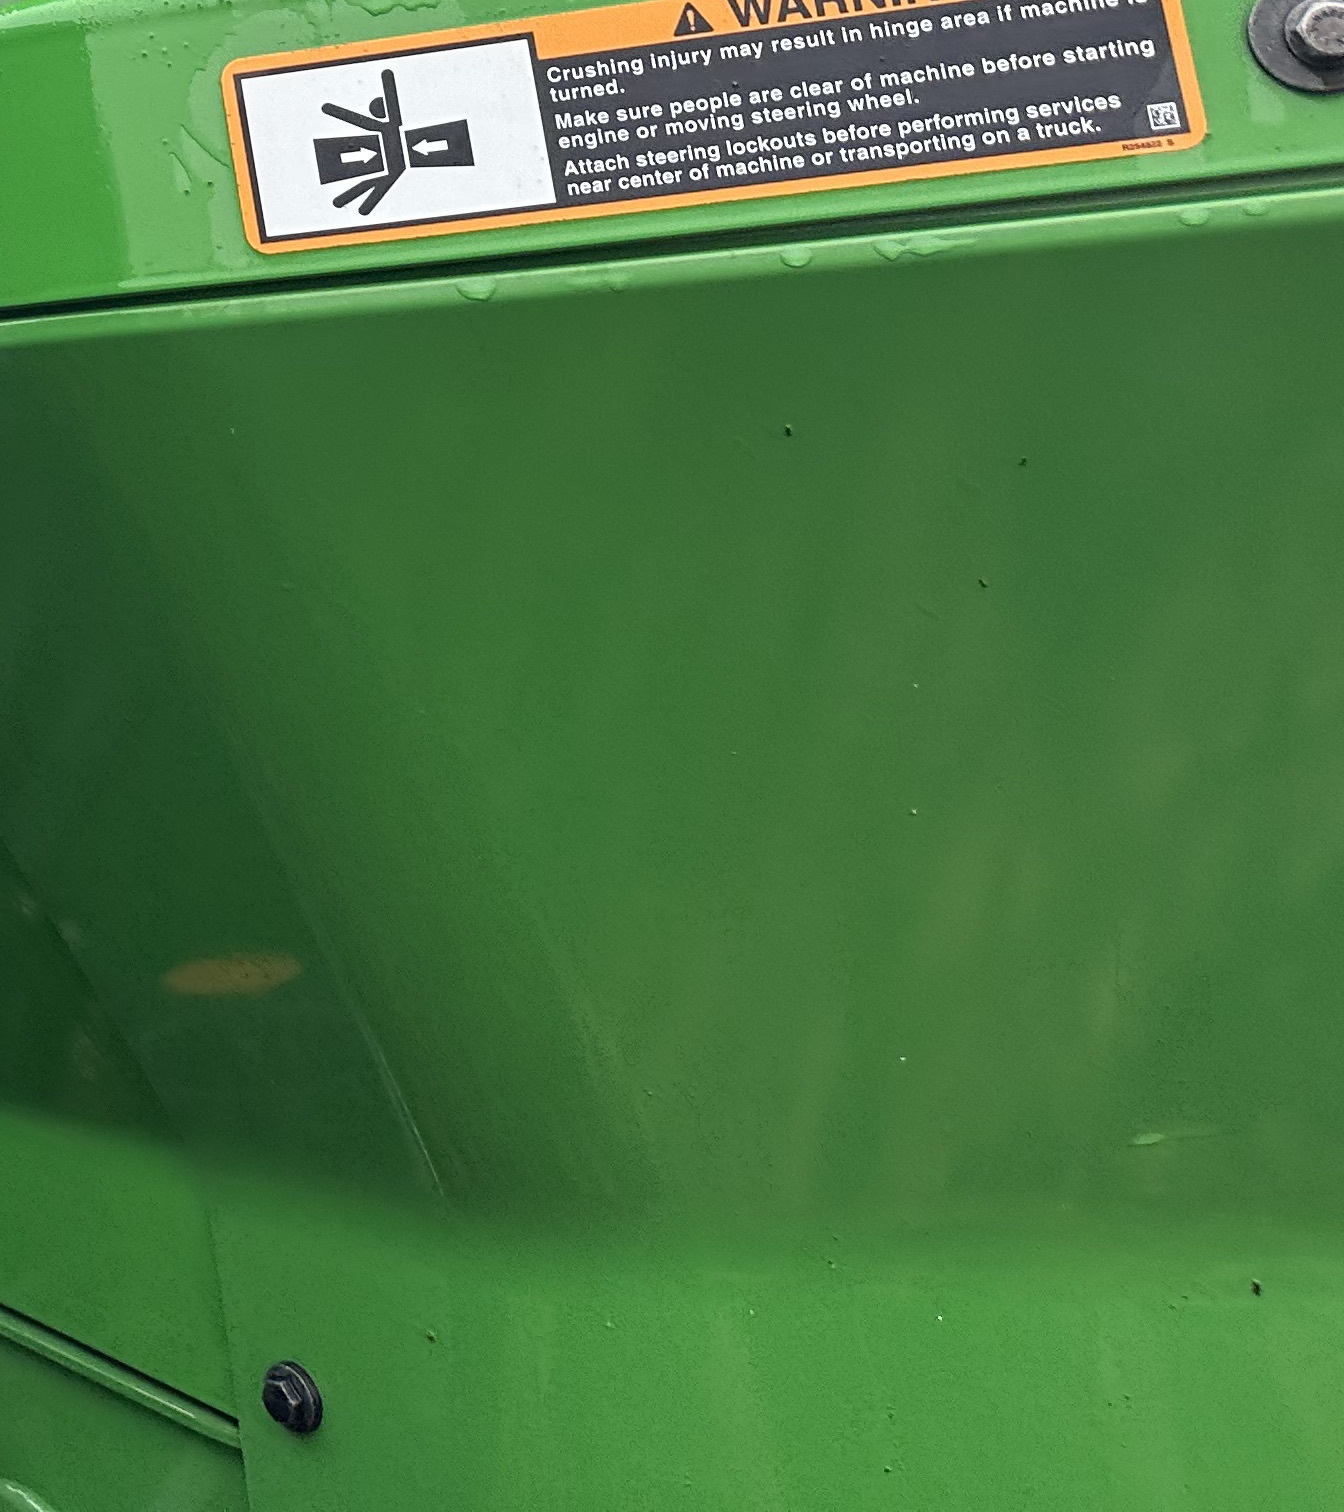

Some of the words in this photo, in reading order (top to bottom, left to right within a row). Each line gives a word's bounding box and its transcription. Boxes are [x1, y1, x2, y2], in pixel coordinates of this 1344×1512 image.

[547, 58, 643, 82] Crushing
[650, 49, 711, 70] injury
[720, 42, 763, 59] may
[772, 30, 835, 52] result
[841, 27, 862, 43] in
[870, 15, 932, 38] hinge
[941, 11, 989, 30] area
[997, 5, 1012, 22] if
[550, 80, 625, 102] turned.
[555, 110, 609, 129] Make
[616, 104, 662, 121] sure
[670, 91, 742, 118] people
[749, 88, 783, 105] are
[790, 81, 843, 99] clear
[851, 73, 872, 91] of
[880, 62, 974, 88] machine
[982, 52, 1055, 74] before
[1063, 39, 1155, 64] starting
[559, 129, 629, 149] engine
[636, 125, 657, 138] or
[665, 114, 744, 136] moving
[751, 101, 841, 124] steering
[847, 89, 920, 112] wheel.
[565, 154, 629, 176] Attach
[636, 145, 720, 167] steering
[726, 131, 816, 156] lockouts
[823, 123, 891, 144] before
[898, 108, 1020, 137] performing
[1026, 94, 1122, 119] services
[568, 178, 611, 195] near
[618, 169, 682, 189] center
[689, 164, 709, 181] of
[716, 154, 804, 178] machine
[812, 150, 833, 165] or
[840, 134, 976, 162] transporting
[982, 130, 1010, 145] on
[1017, 127, 1030, 141] a
[1036, 117, 1102, 137] truck.
